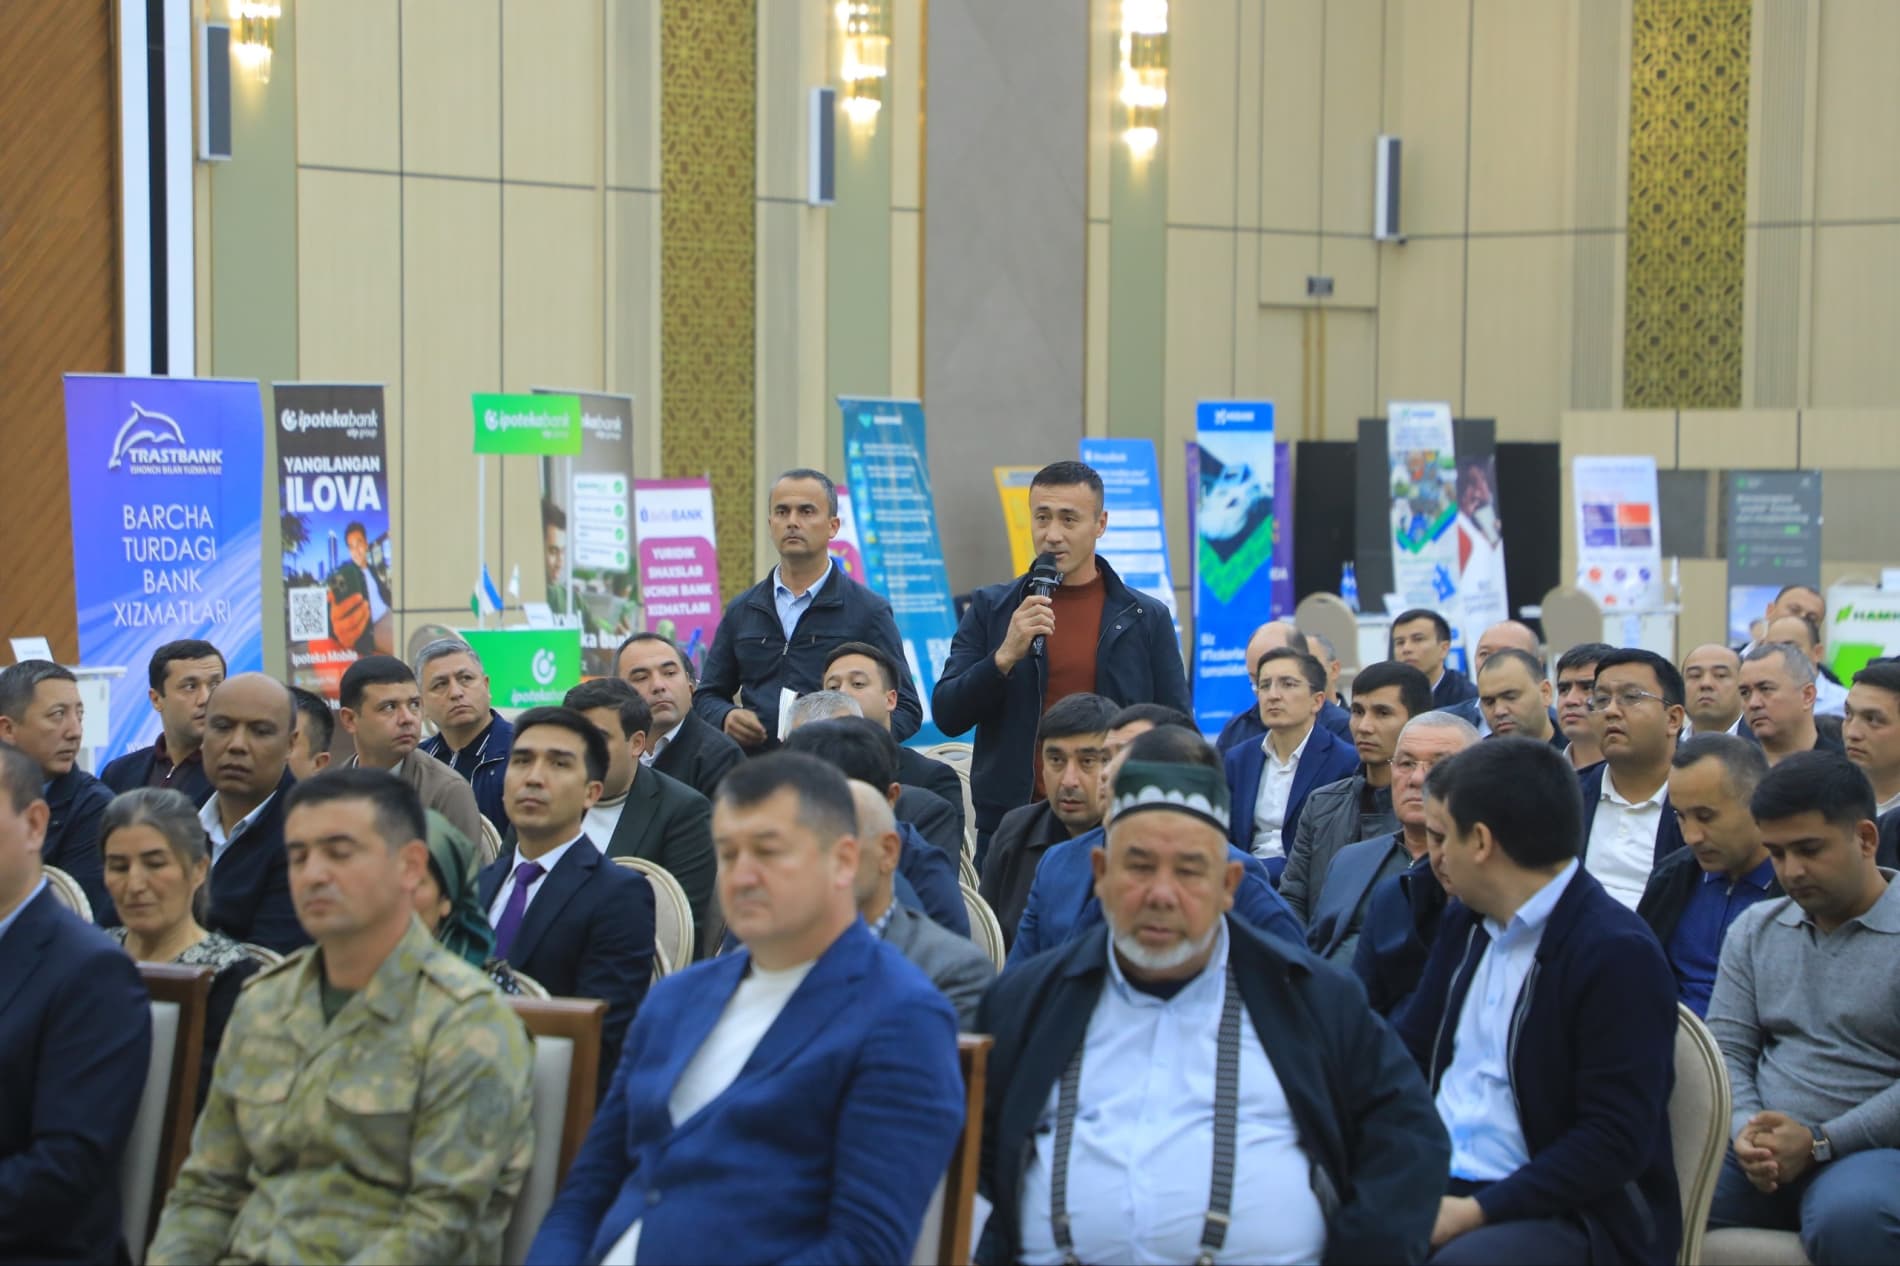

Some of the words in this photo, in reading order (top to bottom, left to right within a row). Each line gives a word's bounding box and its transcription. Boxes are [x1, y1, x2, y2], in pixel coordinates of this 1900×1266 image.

[298, 408, 378, 432] ipotekabank
[129, 448, 223, 464] TRASTBANK
[283, 456, 380, 473] YANGILANGAN
[285, 475, 382, 512] ILOVA
[123, 504, 214, 530] BARCHA
[122, 536, 216, 562] TURDAGI
[143, 568, 202, 594] BANK
[681, 583, 713, 596] BANK
[113, 601, 231, 627] XIZMATLARI
[292, 652, 327, 667] Ipoteka
[327, 648, 359, 662] Mobile
